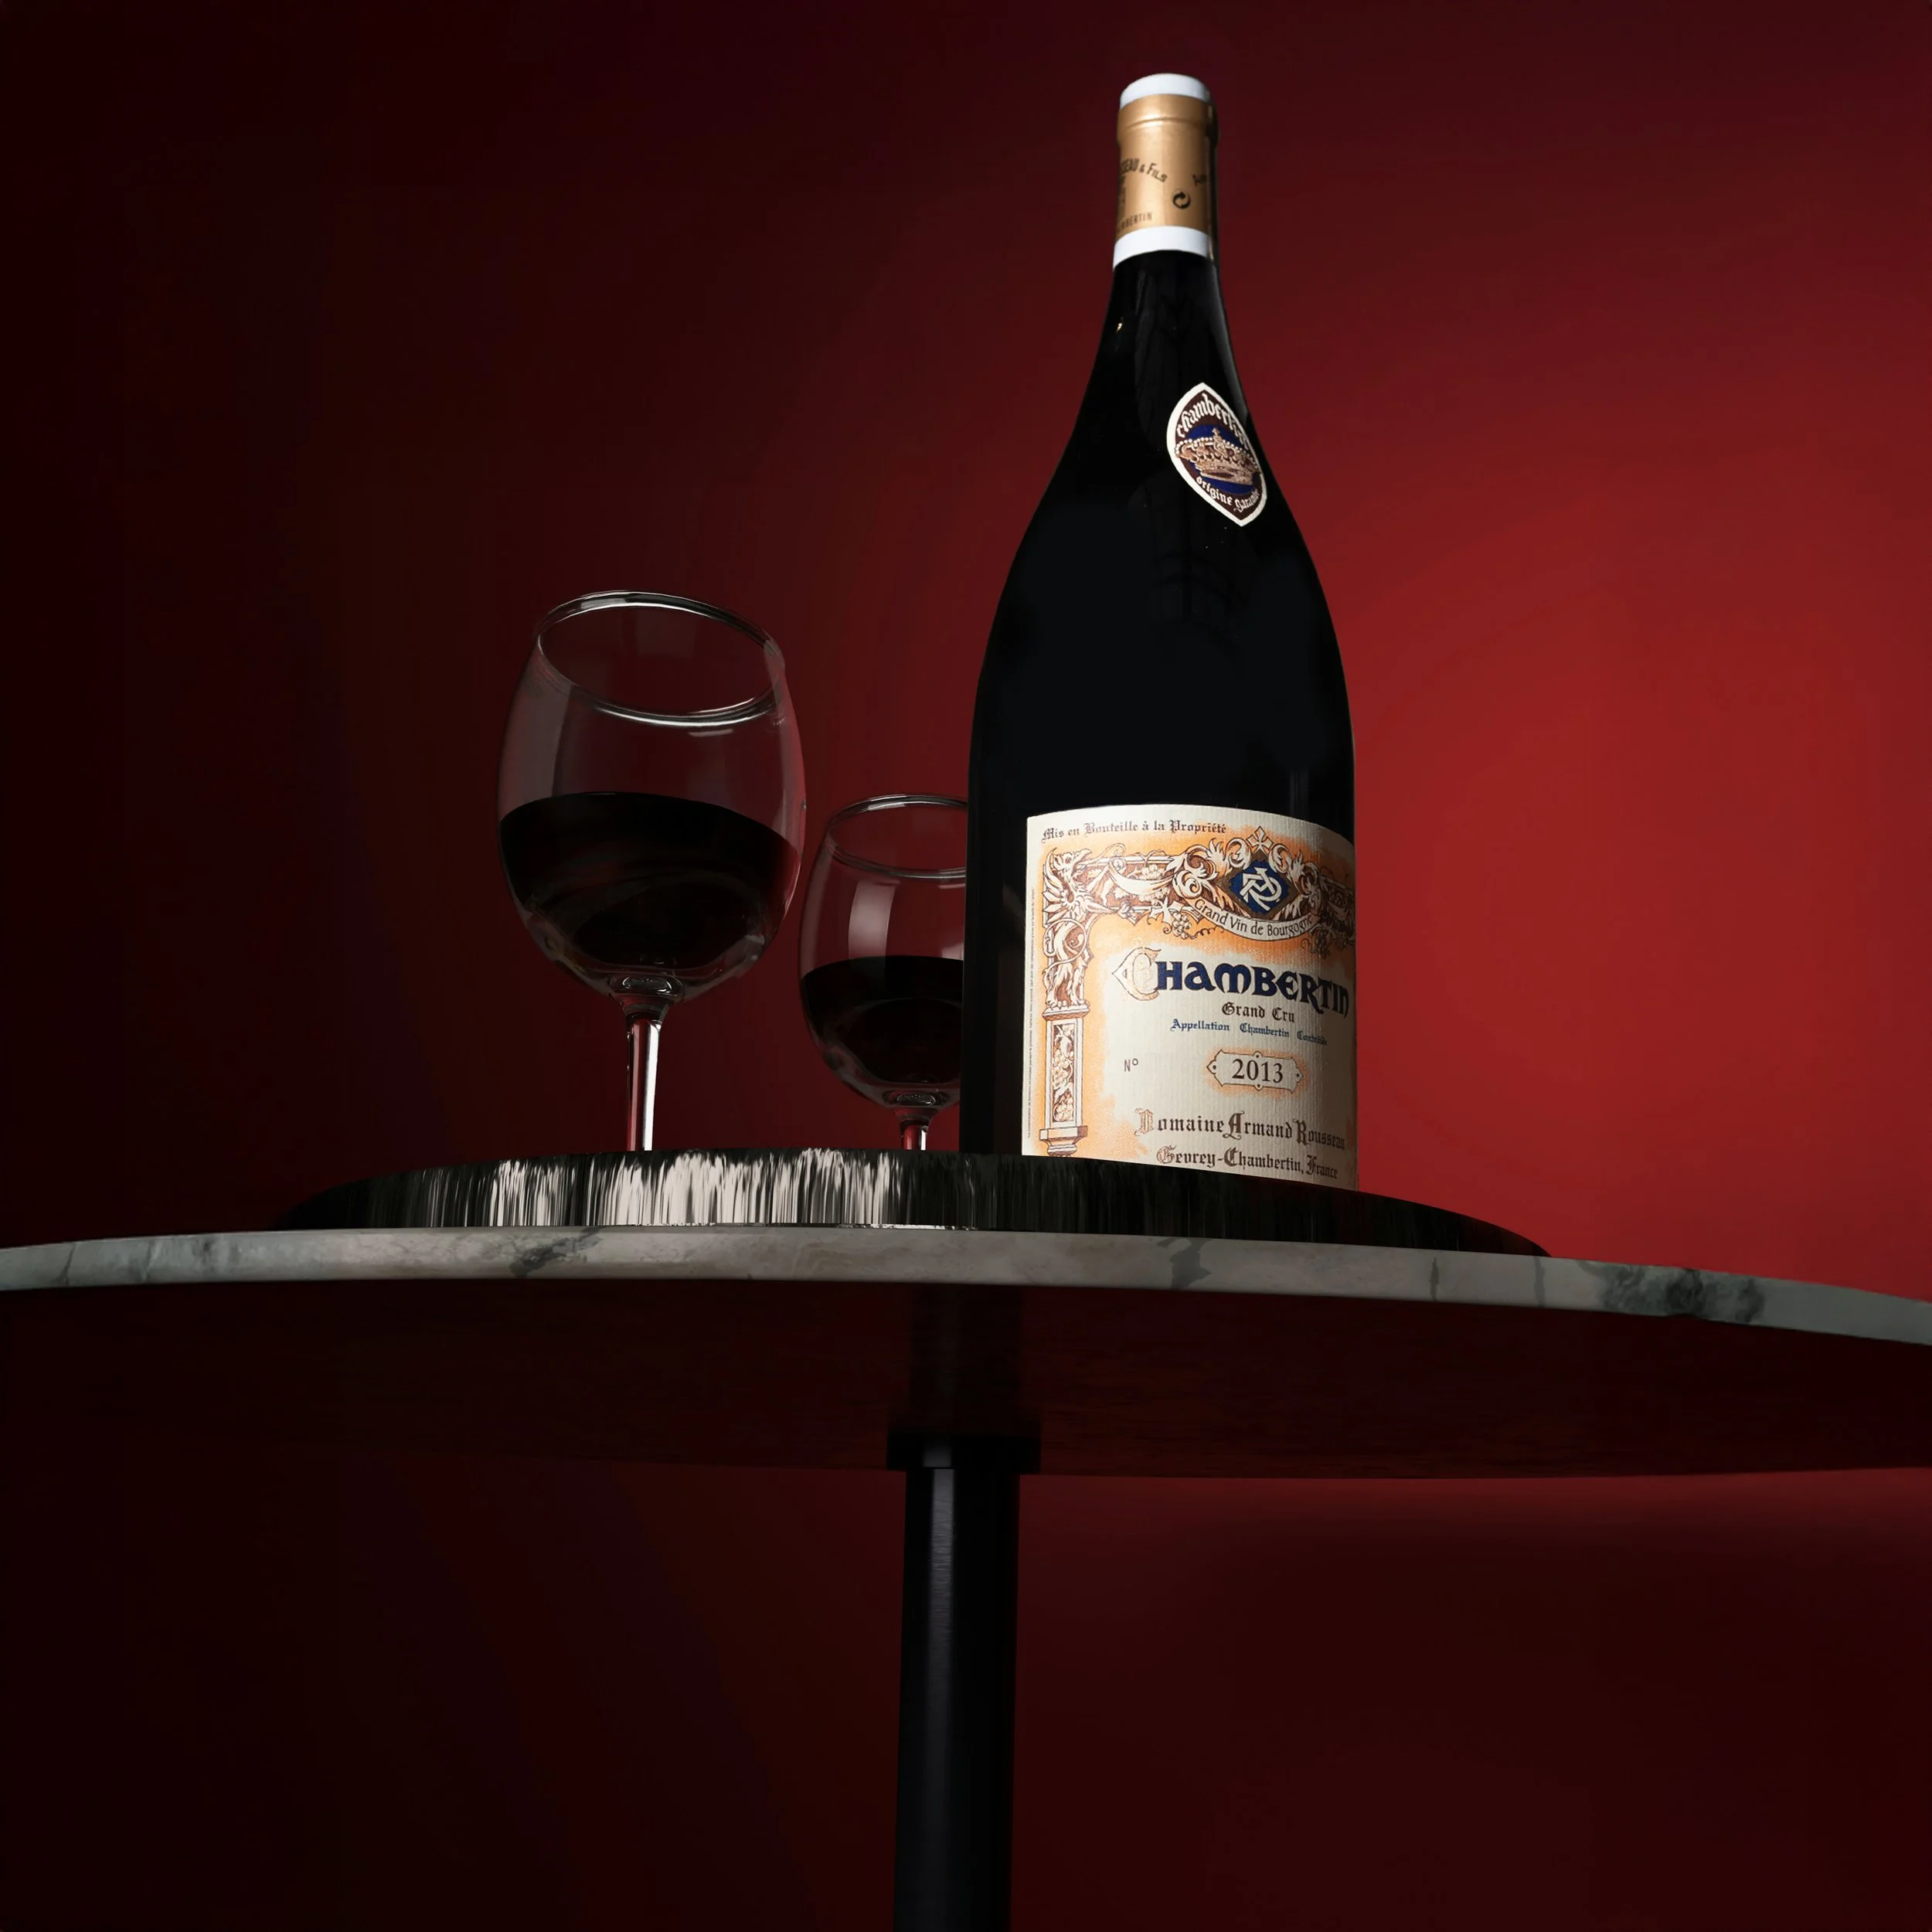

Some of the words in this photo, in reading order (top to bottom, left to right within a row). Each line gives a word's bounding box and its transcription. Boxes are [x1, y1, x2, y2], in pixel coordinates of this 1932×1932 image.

[1041, 828, 1064, 843] Mis
[1083, 821, 1138, 835] Bouteille
[1142, 820, 1149, 831] à
[1154, 821, 1165, 831] la
[1169, 820, 1226, 834] Propriété
[1195, 899, 1227, 925] Grand
[1230, 917, 1247, 932] Vin
[1250, 921, 1264, 935] de
[1267, 916, 1312, 938] Bourgogne
[1222, 1002, 1265, 1019] Grand
[1271, 1008, 1295, 1023] Cru
[1170, 1019, 1230, 1032] Appellation
[1240, 1022, 1289, 1038] Chambertin
[1232, 1059, 1284, 1083] 2013
[1134, 1107, 1224, 1136] Domaine
[1223, 1111, 1293, 1140] Armand
[1293, 1117, 1345, 1150] Rousseau
[1305, 1155, 1338, 1179] France
